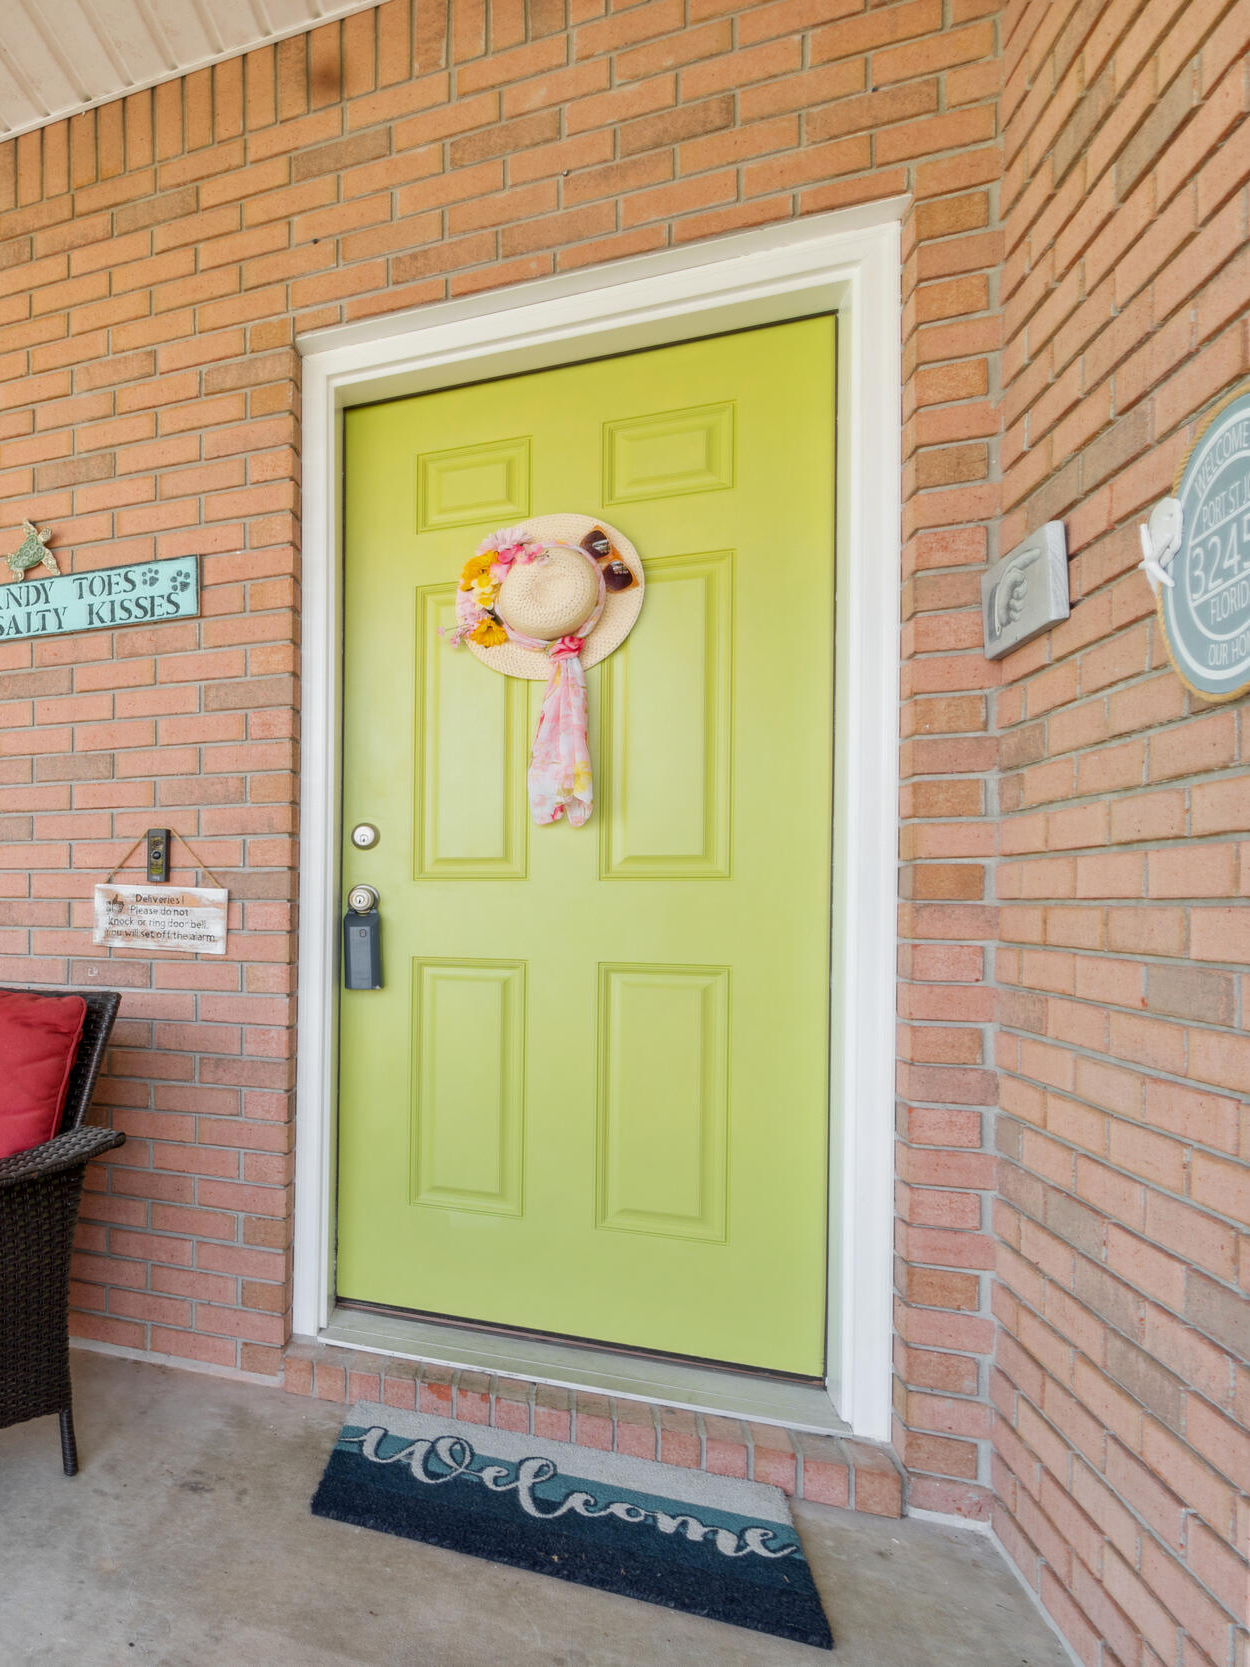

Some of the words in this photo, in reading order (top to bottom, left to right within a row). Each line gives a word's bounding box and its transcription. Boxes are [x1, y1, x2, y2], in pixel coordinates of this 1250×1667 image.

[1194, 421, 1250, 498] WELCOME
[1202, 491, 1227, 531] PORT
[1229, 481, 1241, 513] ST
[72, 570, 137, 600] TOES
[87, 592, 181, 626] KISSES
[1210, 580, 1250, 625] FLORID
[1208, 643, 1229, 666] OUR
[1231, 631, 1250, 662] HO
[108, 916, 134, 926] knock
[137, 918, 147, 927] or
[148, 917, 166, 929] ring
[167, 917, 188, 928] door
[130, 905, 158, 915] Please
[160, 905, 172, 916] do
[173, 907, 189, 916] not
[105, 927, 122, 937] You
[124, 928, 139, 937] will
[141, 929, 155, 938] set
[156, 928, 170, 939] off
[173, 929, 188, 940] the
